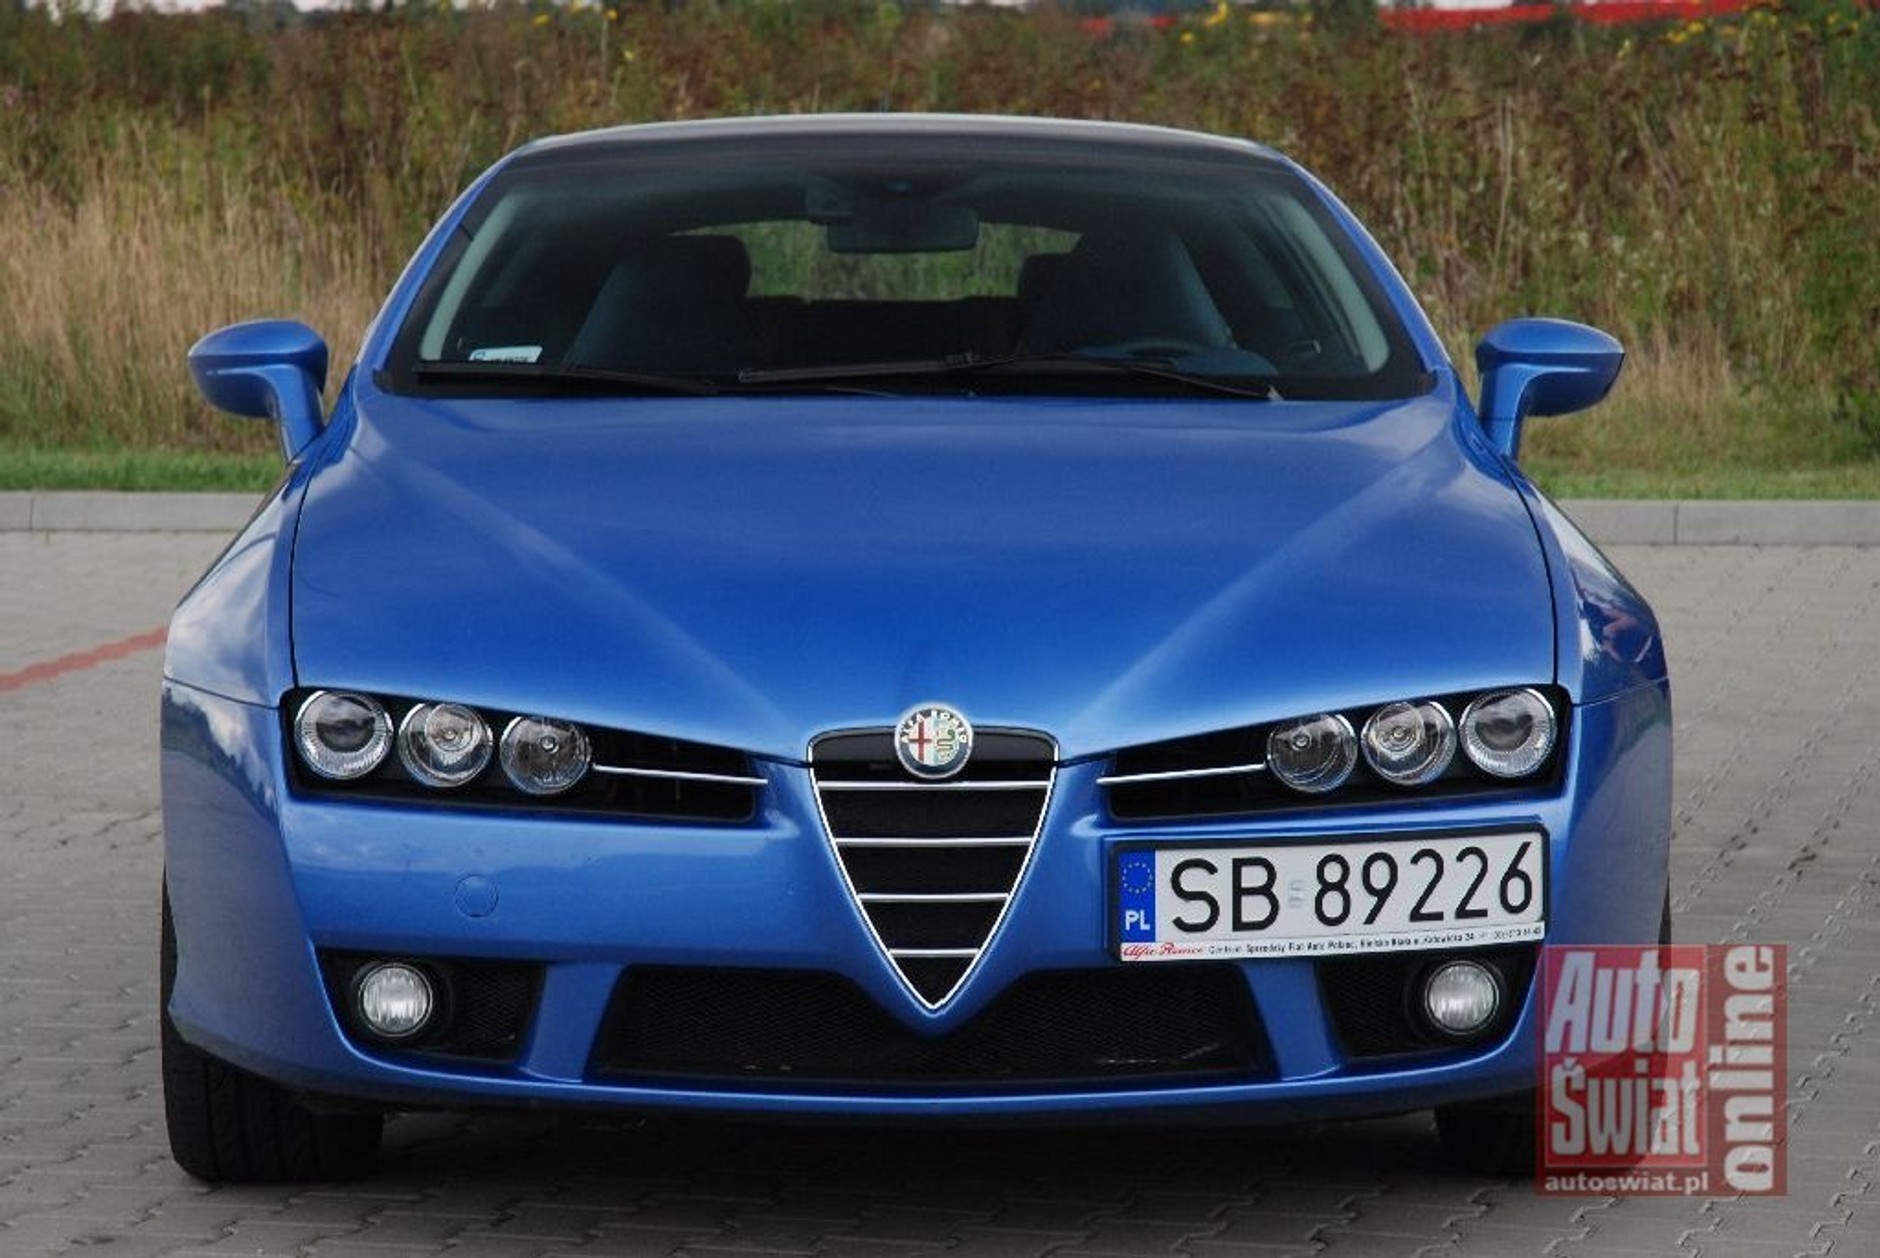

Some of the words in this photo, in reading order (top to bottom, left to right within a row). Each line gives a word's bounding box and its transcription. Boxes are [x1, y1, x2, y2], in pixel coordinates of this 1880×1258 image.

[1170, 857, 1281, 933] SB
[1314, 841, 1533, 927] 89226
[1124, 909, 1151, 931] PL
